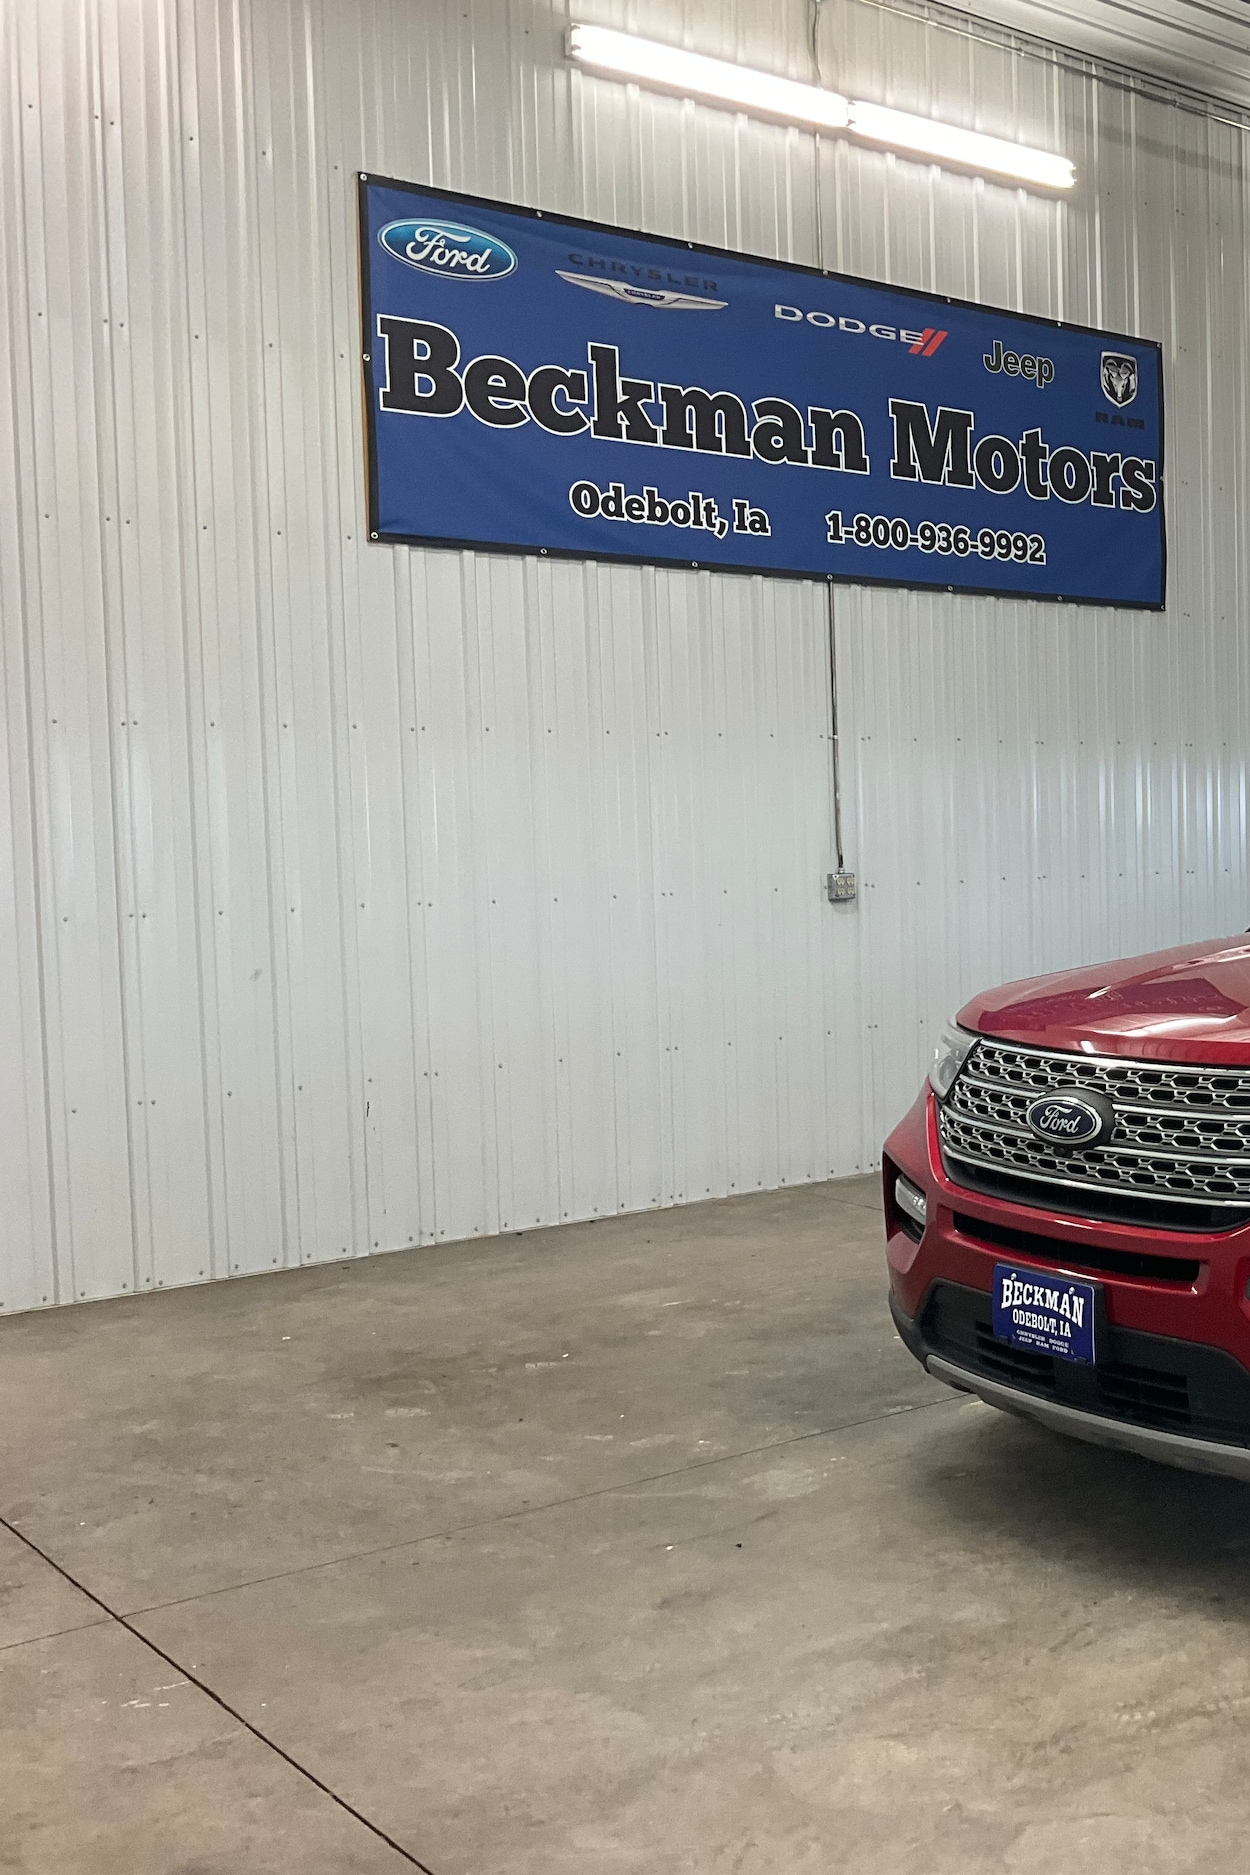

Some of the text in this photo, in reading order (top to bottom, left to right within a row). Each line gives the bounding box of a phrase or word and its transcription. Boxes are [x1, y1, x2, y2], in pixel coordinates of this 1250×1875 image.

[406, 226, 492, 273] Ford
[568, 253, 718, 292] CHRYSLER
[774, 304, 924, 346] DODGE
[982, 340, 1054, 388] Jeep
[377, 313, 1156, 513] Beckman Motors
[1095, 411, 1145, 430] RAM
[569, 480, 771, 539] Odebolt, Ia
[825, 511, 1047, 565] 1-800-936-9992
[1040, 1105, 1081, 1133] Ford
[1001, 1279, 1084, 1328] BECKMAN
[1012, 1309, 1071, 1338] ODEBOLT, IA
